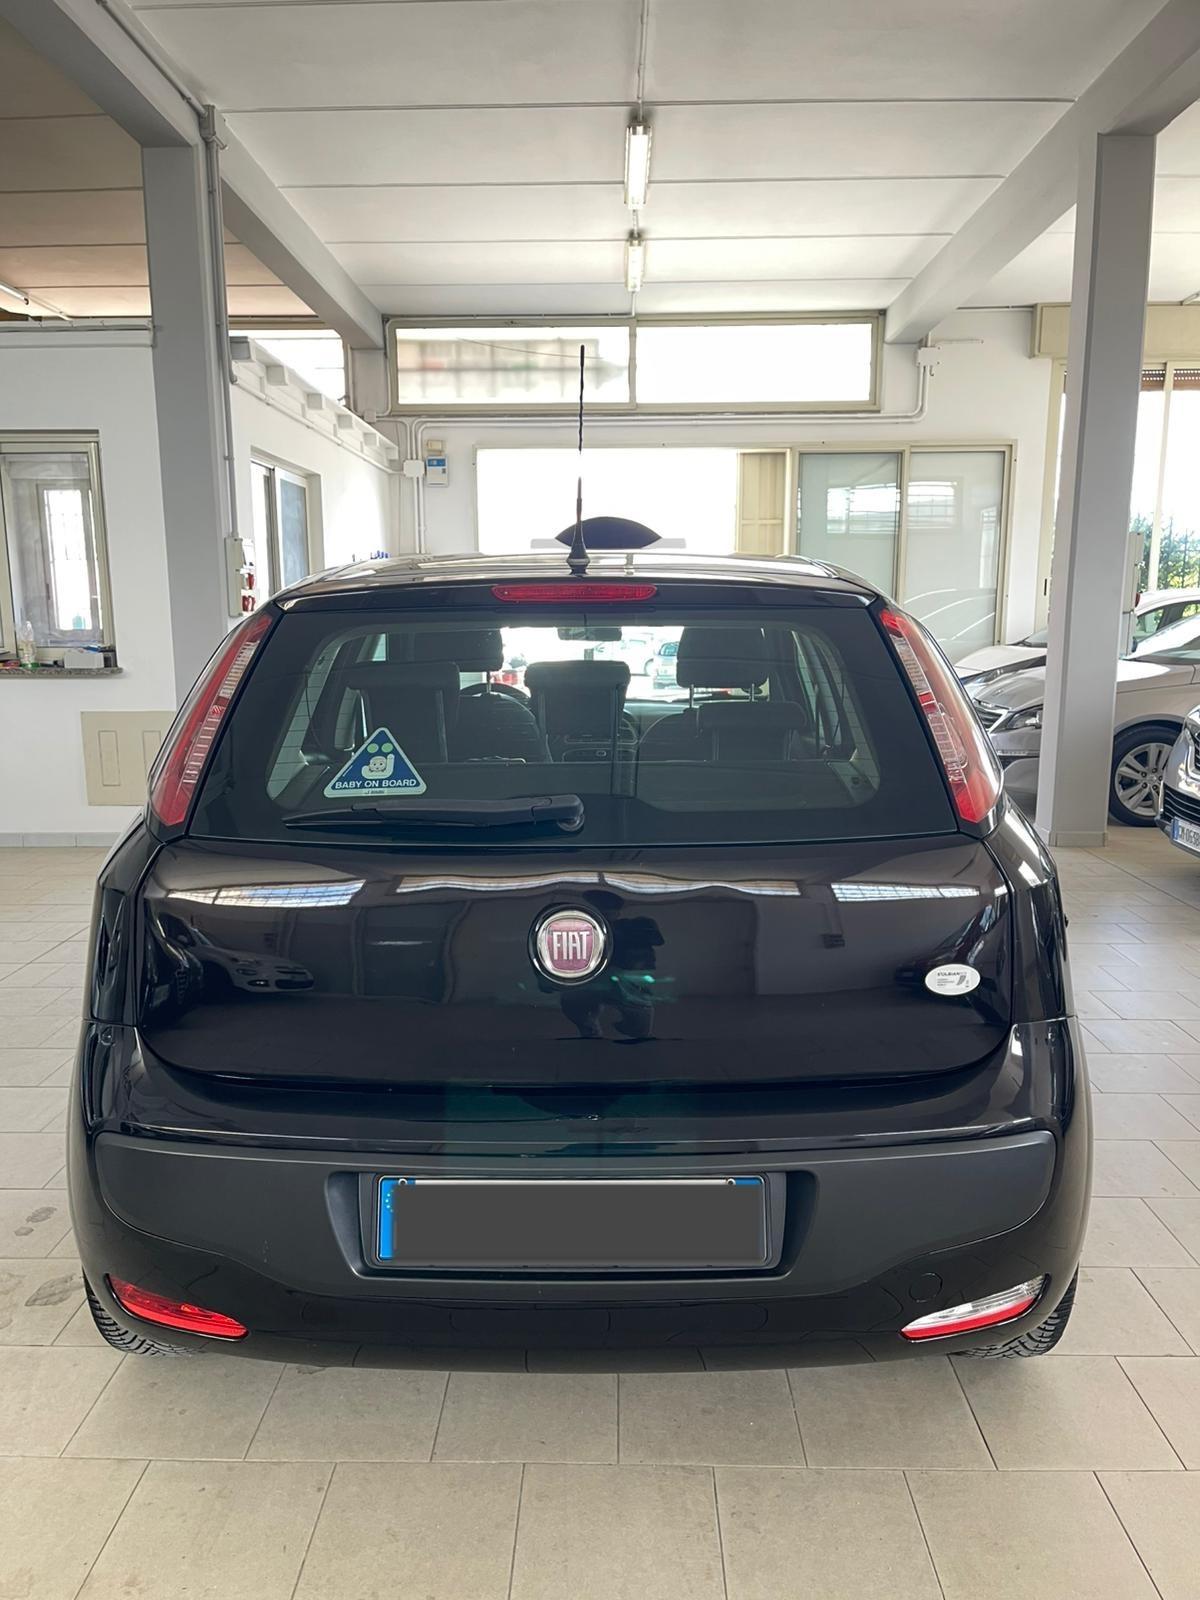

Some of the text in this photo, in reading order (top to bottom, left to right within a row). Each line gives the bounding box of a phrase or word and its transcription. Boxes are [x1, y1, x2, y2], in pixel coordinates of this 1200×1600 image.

[335, 781, 362, 789] BABY
[382, 779, 417, 787] BOARD
[552, 931, 590, 960] FIAT
